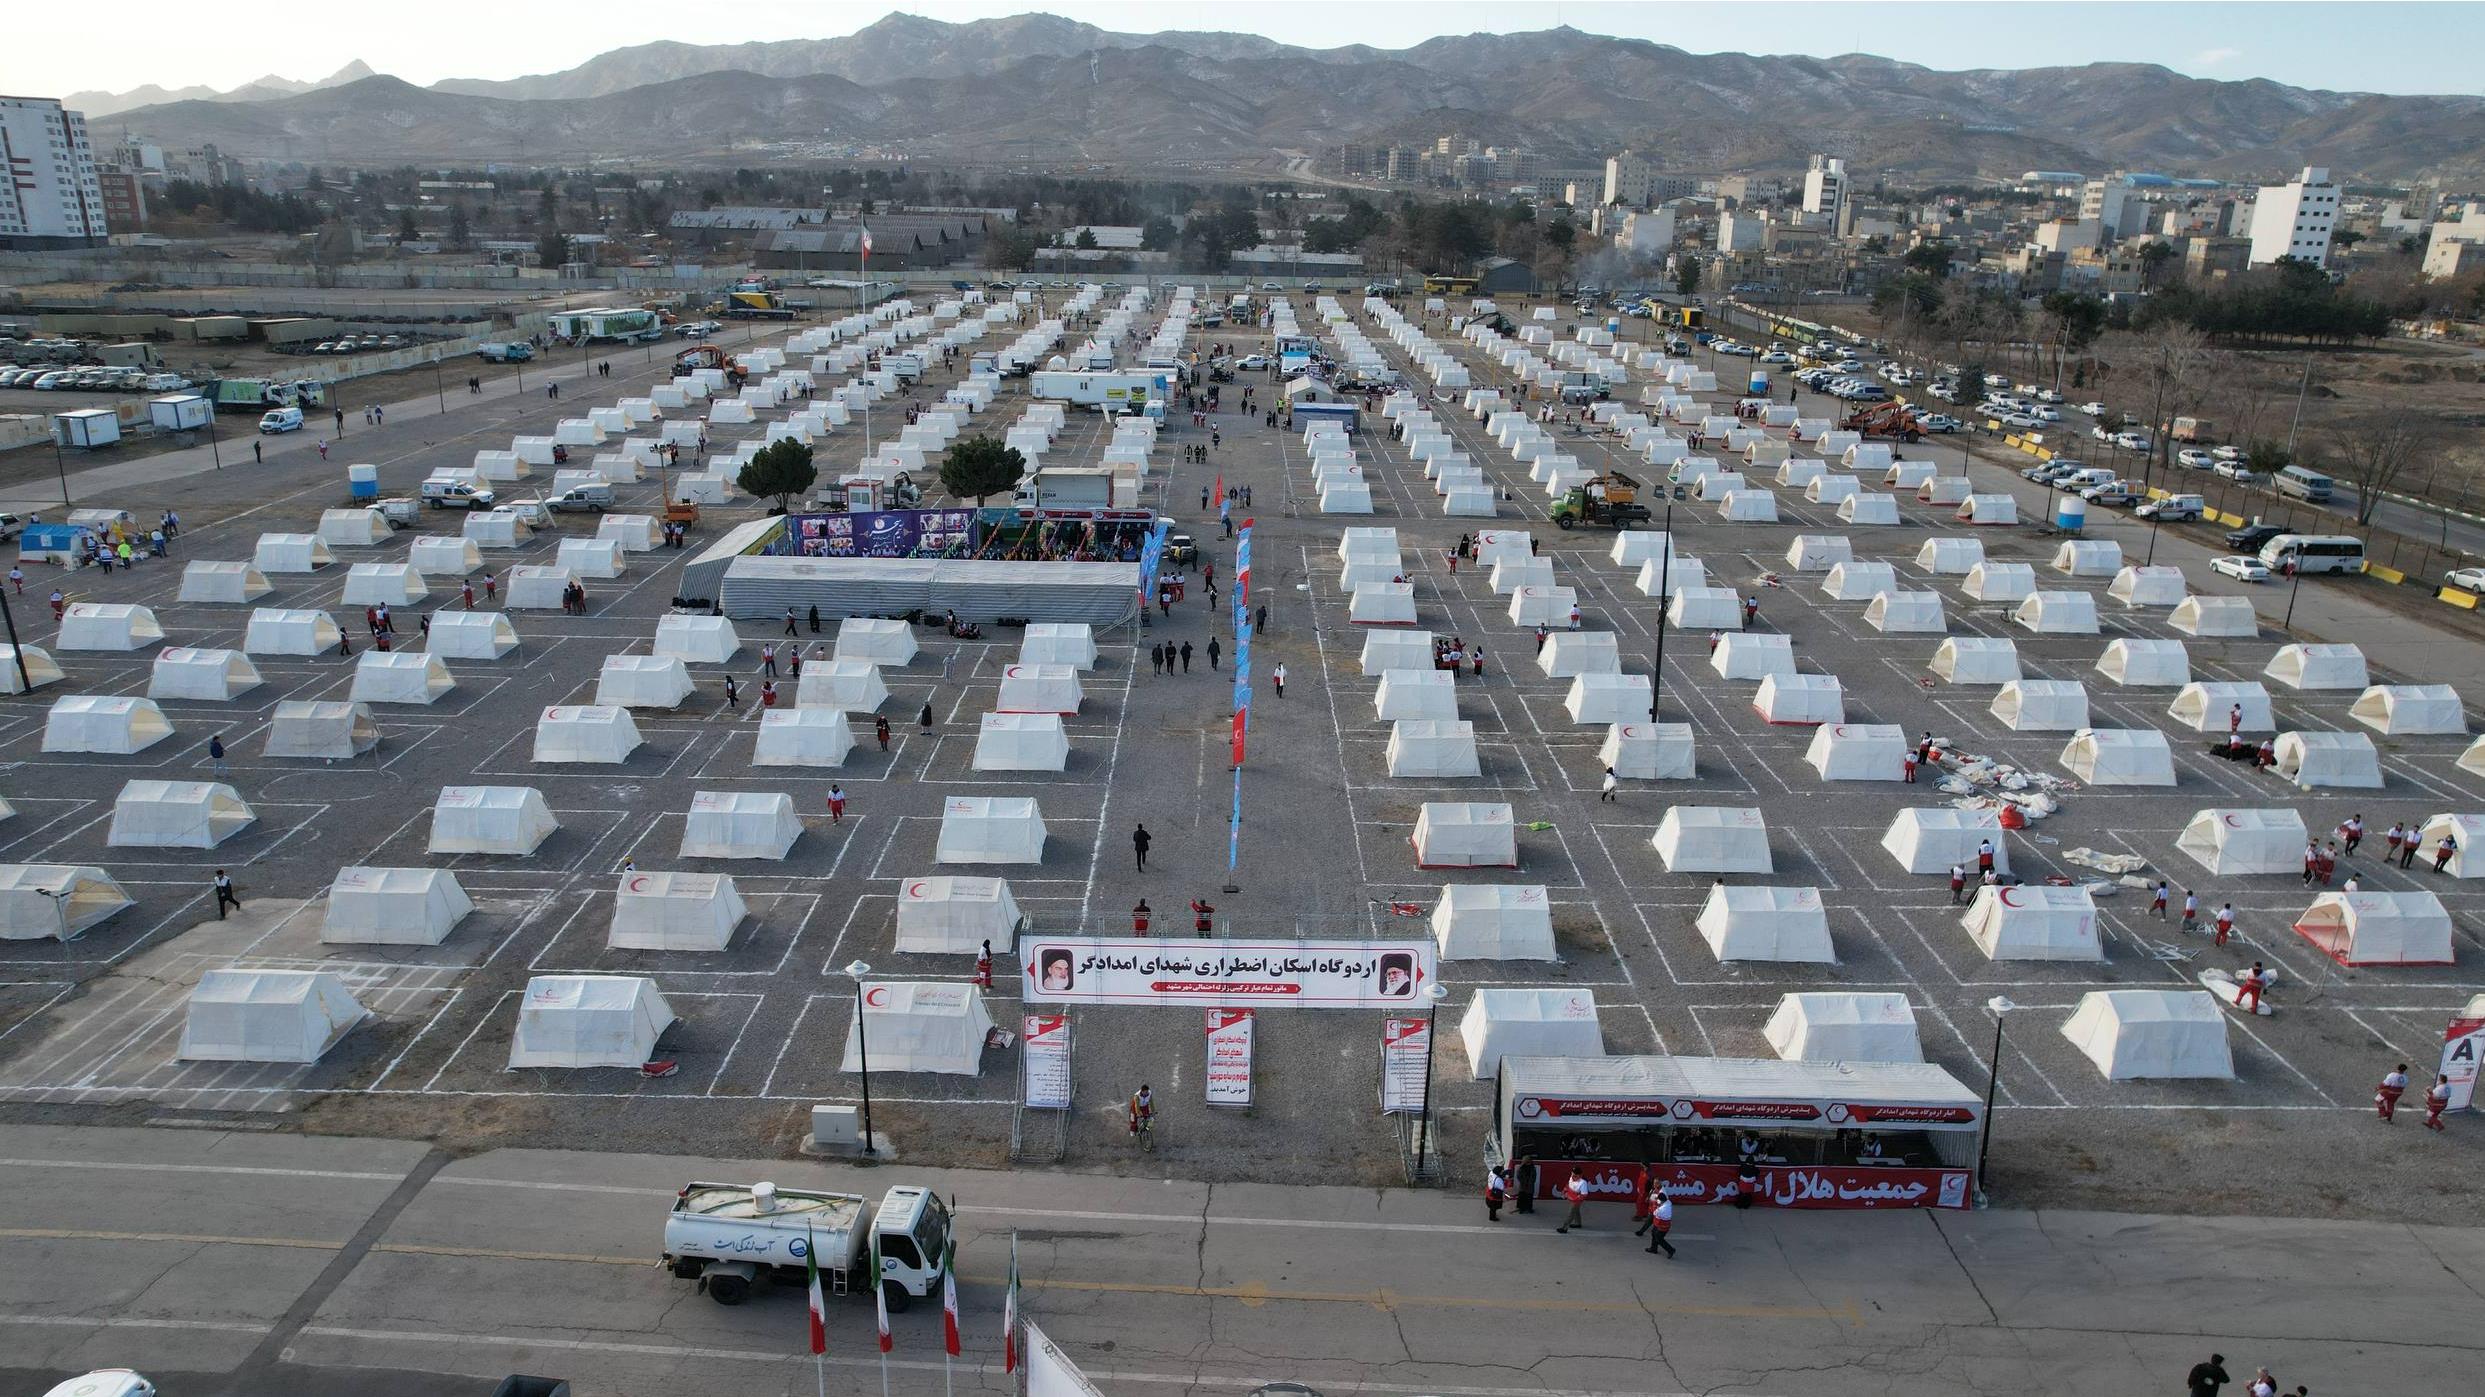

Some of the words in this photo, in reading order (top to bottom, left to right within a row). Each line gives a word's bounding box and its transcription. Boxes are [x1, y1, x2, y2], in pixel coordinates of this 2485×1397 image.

[1077, 955, 1137, 974] امدادگر
[1139, 955, 1192, 976] شهدای
[1194, 956, 1267, 977] اضطراری
[1269, 958, 1317, 977] اسکان
[1319, 958, 1377, 979] اردوگاه
[2451, 1039, 2473, 1061] A
[1559, 1101, 1583, 1110] امدادگر
[1583, 1101, 1603, 1110] شهدای
[1603, 1102, 1628, 1110] اردوگاه
[1712, 1103, 1735, 1112] امدادگر
[1736, 1103, 1756, 1112] شهدای
[1756, 1104, 1781, 1113] اردوگاه
[1874, 1108, 1899, 1117] امدادگر
[1899, 1108, 1919, 1117] شهدای
[1919, 1108, 1943, 1118] اردوگاه
[1706, 1170, 1773, 1204] امر
[1774, 1171, 1835, 1206] هلال
[1838, 1178, 1929, 1207] جمعیت
